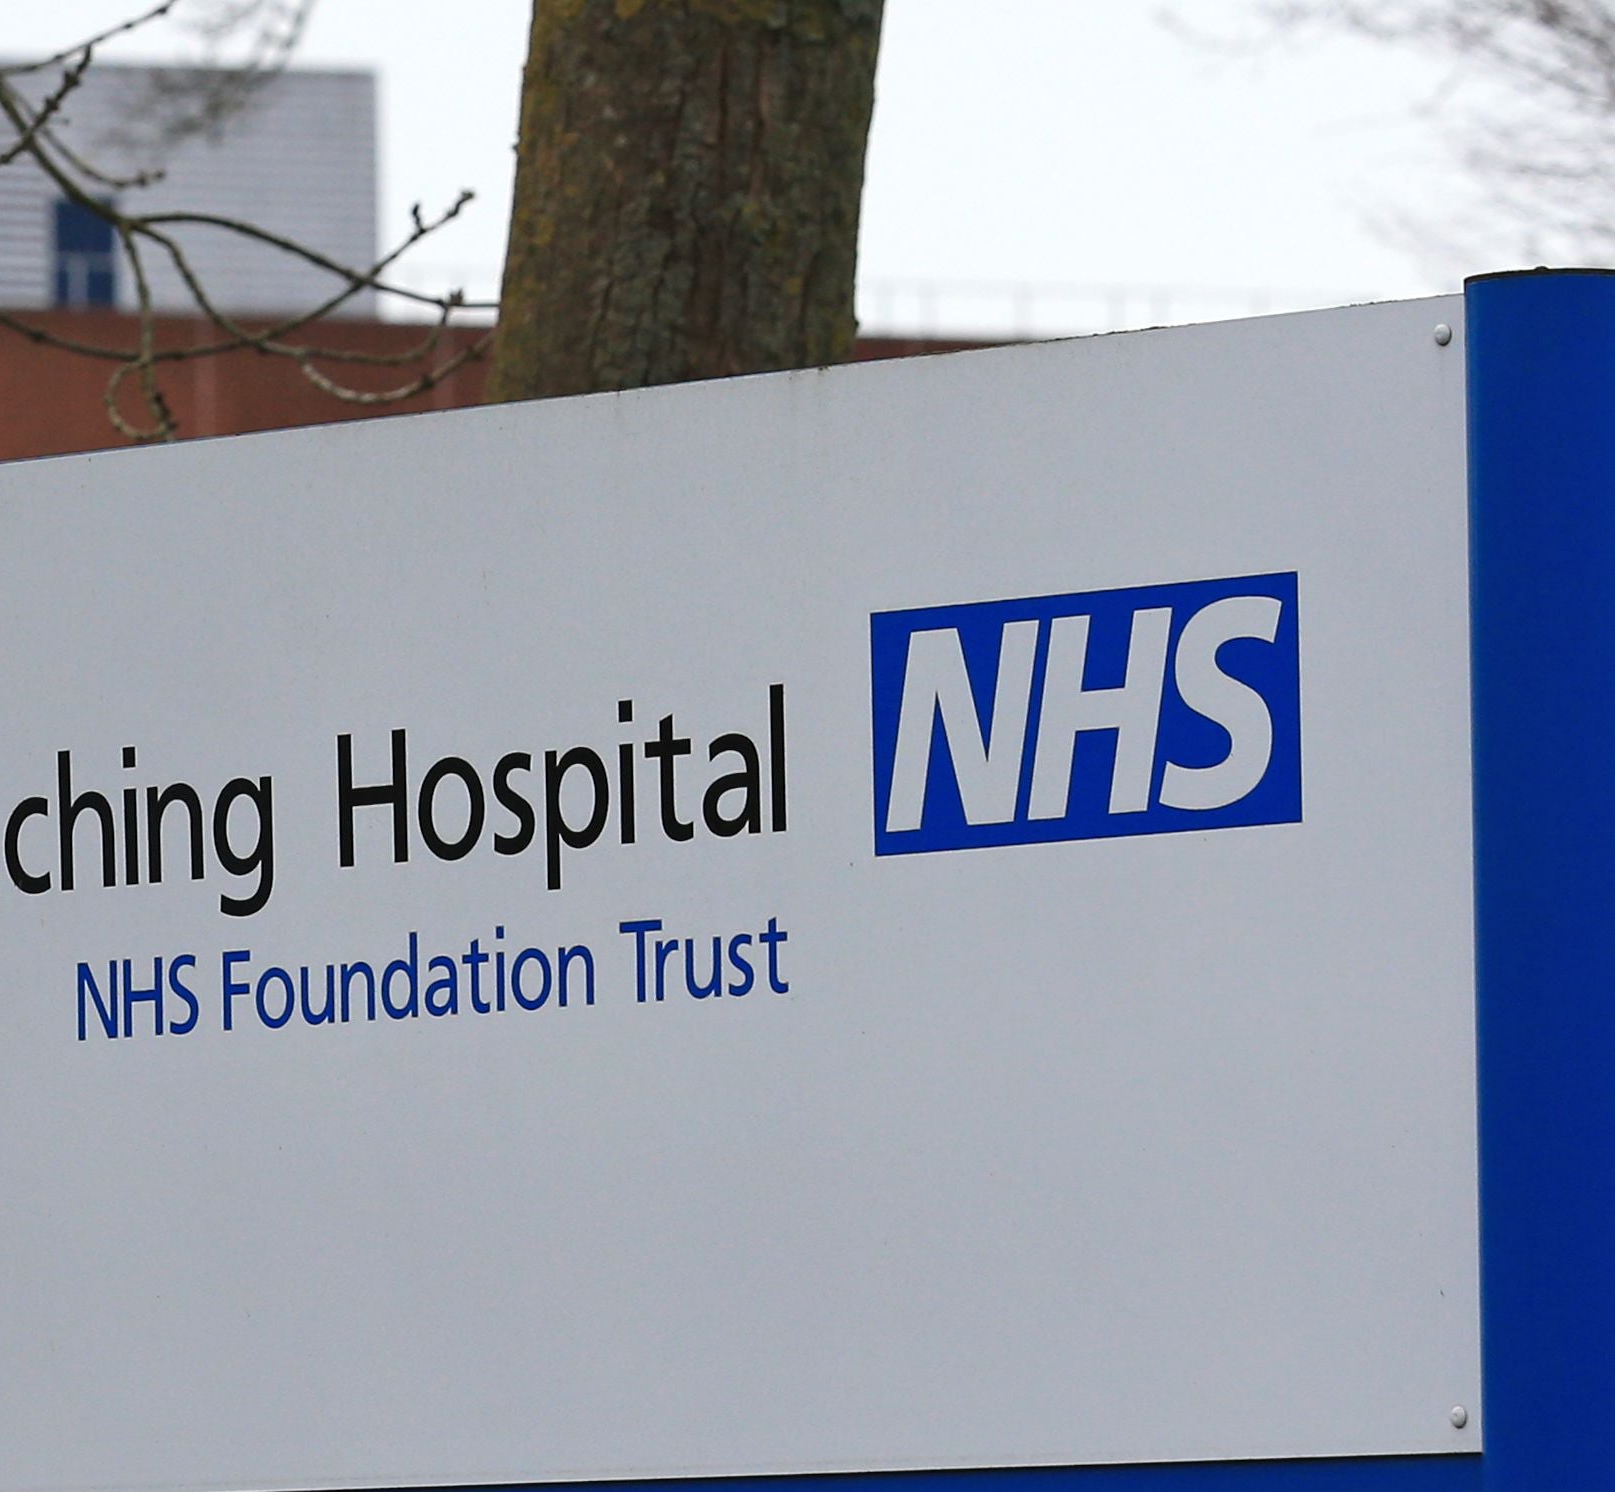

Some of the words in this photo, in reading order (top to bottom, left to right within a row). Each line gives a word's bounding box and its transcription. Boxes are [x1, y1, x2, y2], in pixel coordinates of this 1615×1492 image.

[336, 683, 787, 891] Hospital
[885, 595, 1283, 833] NHS
[76, 954, 200, 1040] NHS
[222, 928, 595, 1030] Foundation
[619, 919, 789, 1003] Trust
